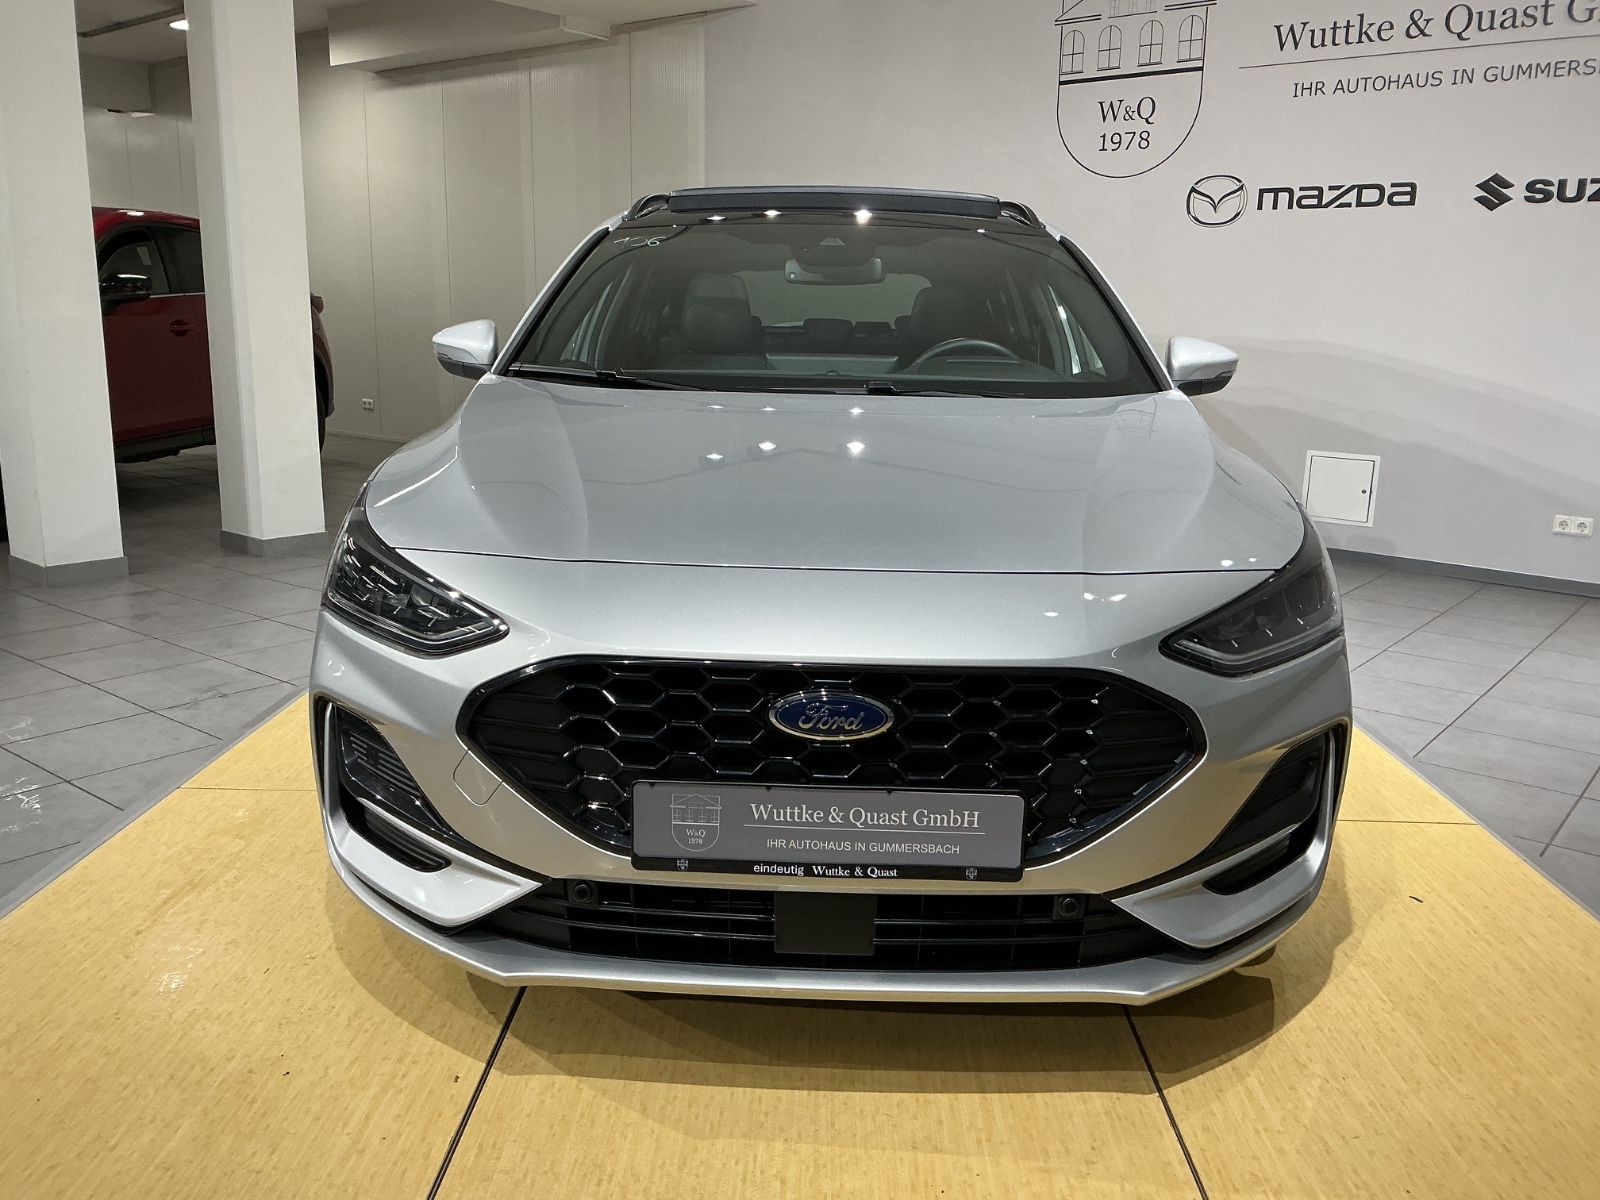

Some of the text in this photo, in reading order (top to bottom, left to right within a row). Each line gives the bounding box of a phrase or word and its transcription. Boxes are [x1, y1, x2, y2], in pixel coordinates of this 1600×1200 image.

[1273, 13, 1395, 52] Wuttke
[1404, 8, 1435, 40] &
[1444, 0, 1556, 41] Quast
[1292, 58, 1600, 98] IHR AUTOHAUS IN GUMMERS
[1097, 96, 1156, 125] W&Q
[1098, 130, 1150, 152] 1978
[798, 702, 866, 730] Ford
[749, 803, 980, 829] Wuttke & Quast GmbH
[766, 838, 960, 855] IHR AUTOHAUS IN GUMMERSBACH
[753, 863, 898, 878] eindeutig Wuttke & Quast
